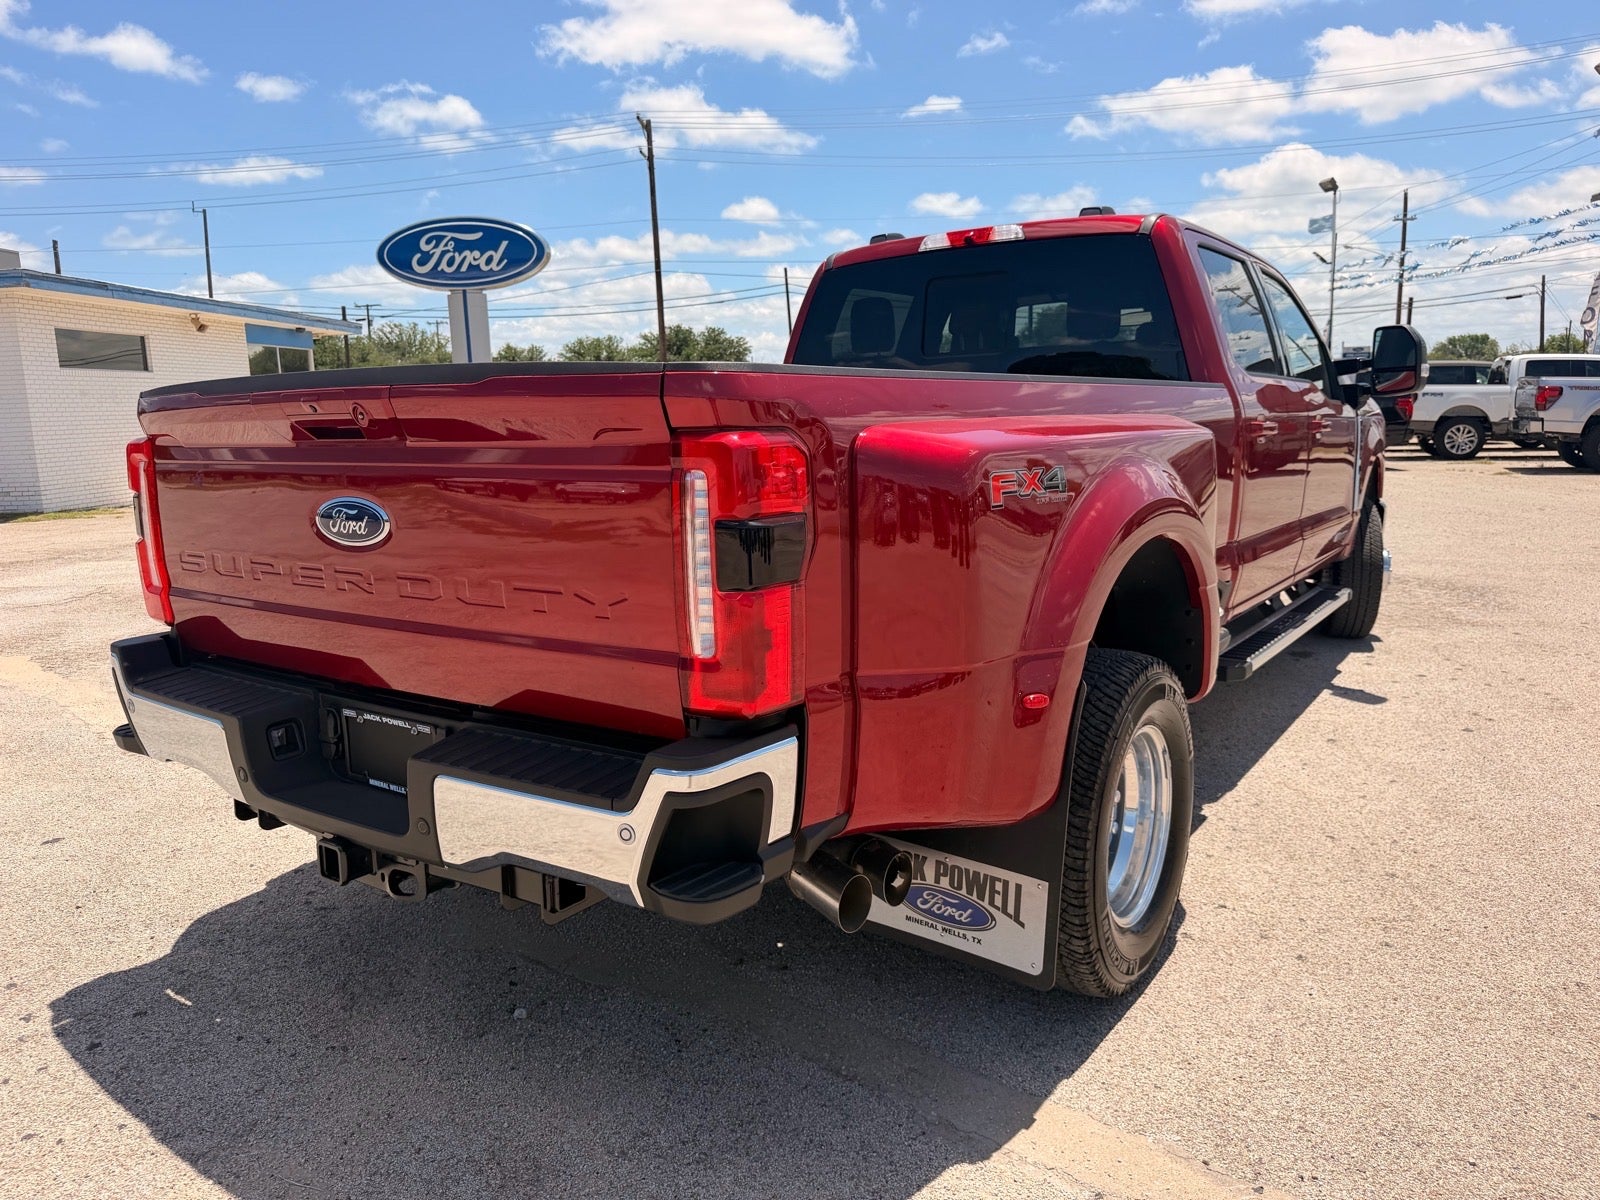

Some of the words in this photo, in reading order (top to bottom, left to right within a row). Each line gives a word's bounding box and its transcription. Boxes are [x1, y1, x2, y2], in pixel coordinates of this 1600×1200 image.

[411, 231, 509, 274] Ford
[989, 465, 1067, 510] FX4
[329, 507, 369, 535] Ford
[179, 550, 375, 595] SUPER
[396, 571, 629, 620] DUTY
[363, 713, 381, 722] JACK
[382, 717, 411, 728] POWELL
[369, 779, 389, 790] MINERAL
[916, 890, 973, 923] Ford
[934, 859, 1025, 929] POWELL
[905, 914, 939, 931] MINERAL
[940, 926, 970, 942] WELLS,
[971, 936, 982, 945] TX
